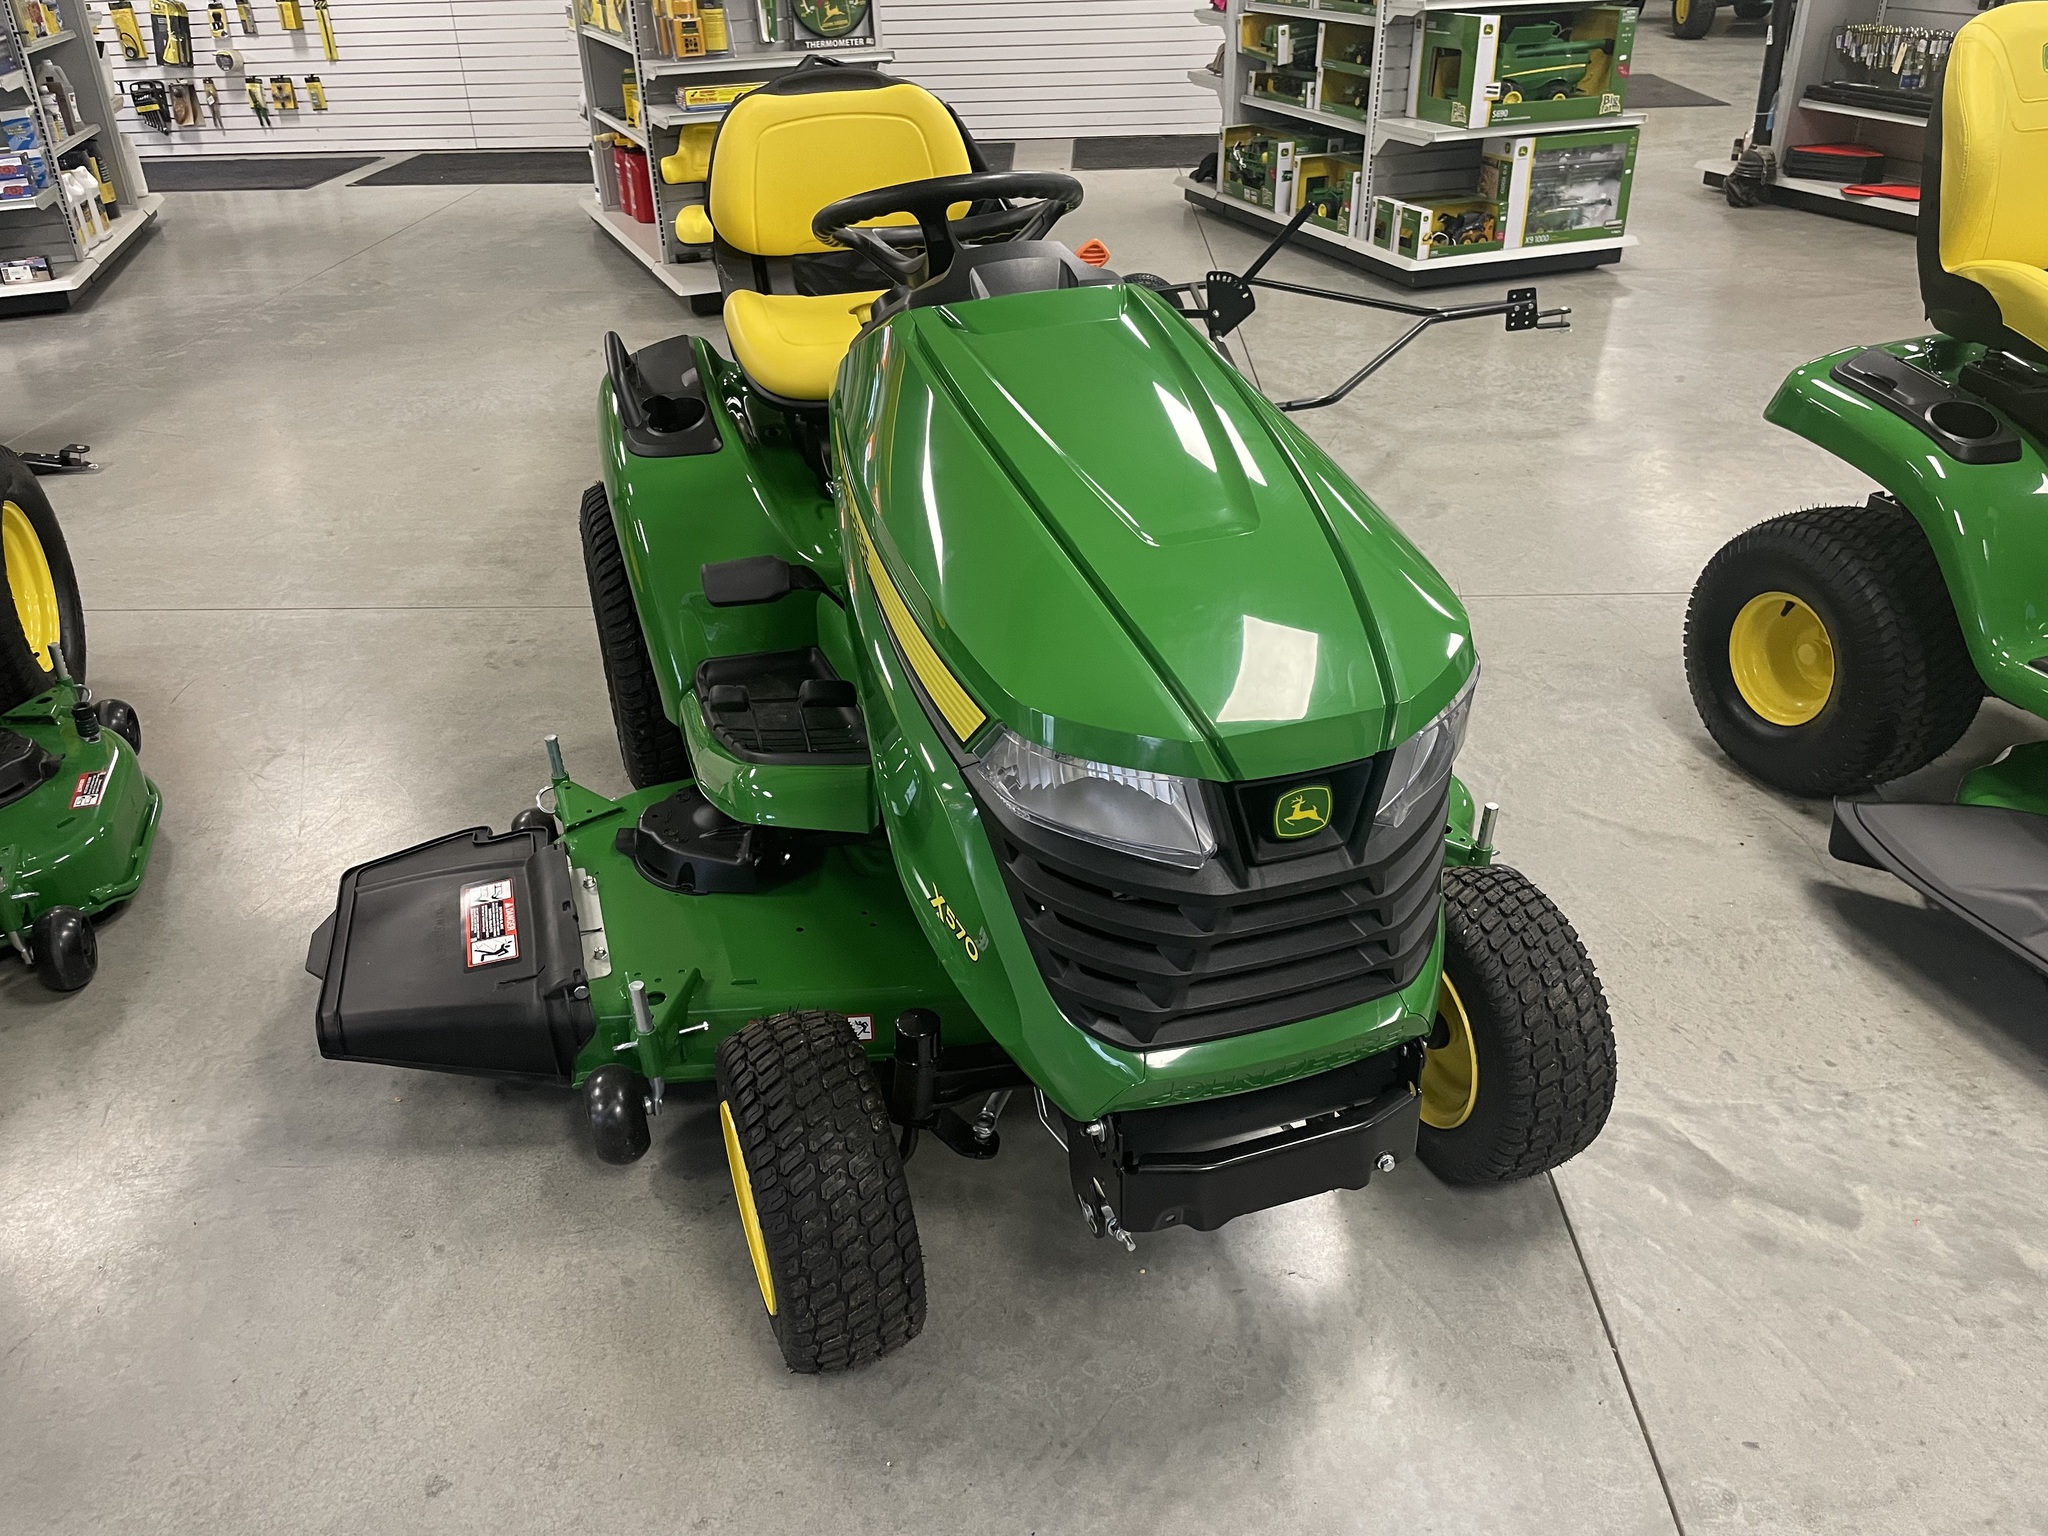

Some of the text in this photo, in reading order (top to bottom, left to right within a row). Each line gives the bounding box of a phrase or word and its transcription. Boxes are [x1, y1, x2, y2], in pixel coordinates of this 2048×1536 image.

[805, 38, 864, 49] THERMOMETER
[1603, 95, 1619, 106] Big
[1492, 109, 1508, 118] S690
[1534, 234, 1550, 243] 1000
[505, 907, 516, 931] DANGER
[930, 881, 980, 963] X570
[1146, 1026, 1404, 1106] JOHN DEERE
